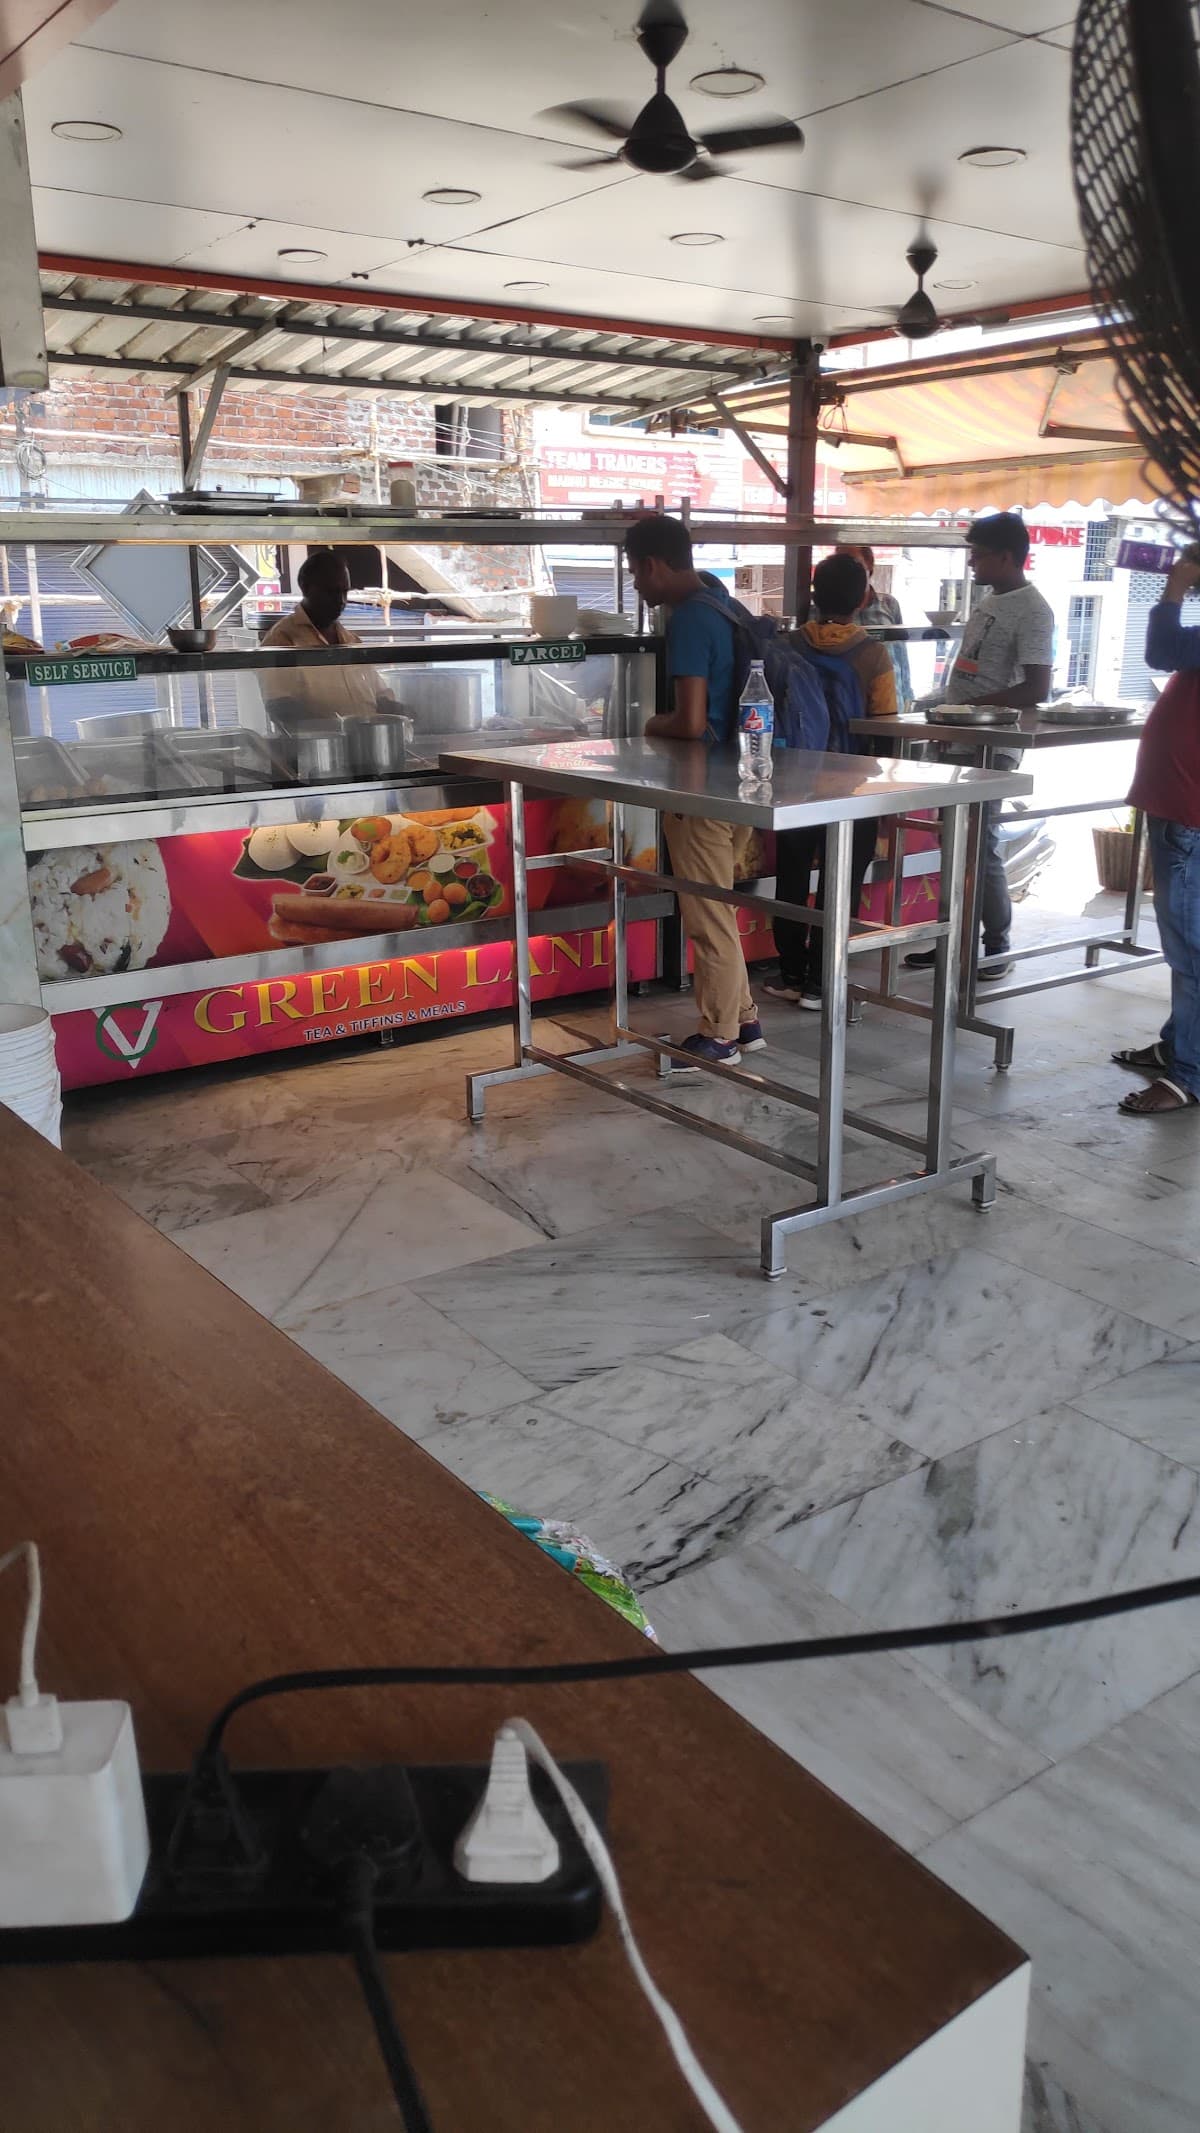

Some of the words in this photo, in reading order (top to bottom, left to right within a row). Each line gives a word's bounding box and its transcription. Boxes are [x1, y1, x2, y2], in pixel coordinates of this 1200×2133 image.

[544, 449, 591, 471] TEAM
[594, 452, 668, 474] TRADERS
[513, 645, 582, 662] PARCEL
[34, 664, 69, 680] SELF
[72, 661, 132, 679] SERVICE
[193, 953, 440, 1034] GREEN
[304, 1027, 332, 1041] TEA
[335, 1023, 347, 1035] &
[350, 1012, 404, 1033] TIFFINS
[406, 1009, 418, 1022] &
[420, 1000, 466, 1019] MEALS
